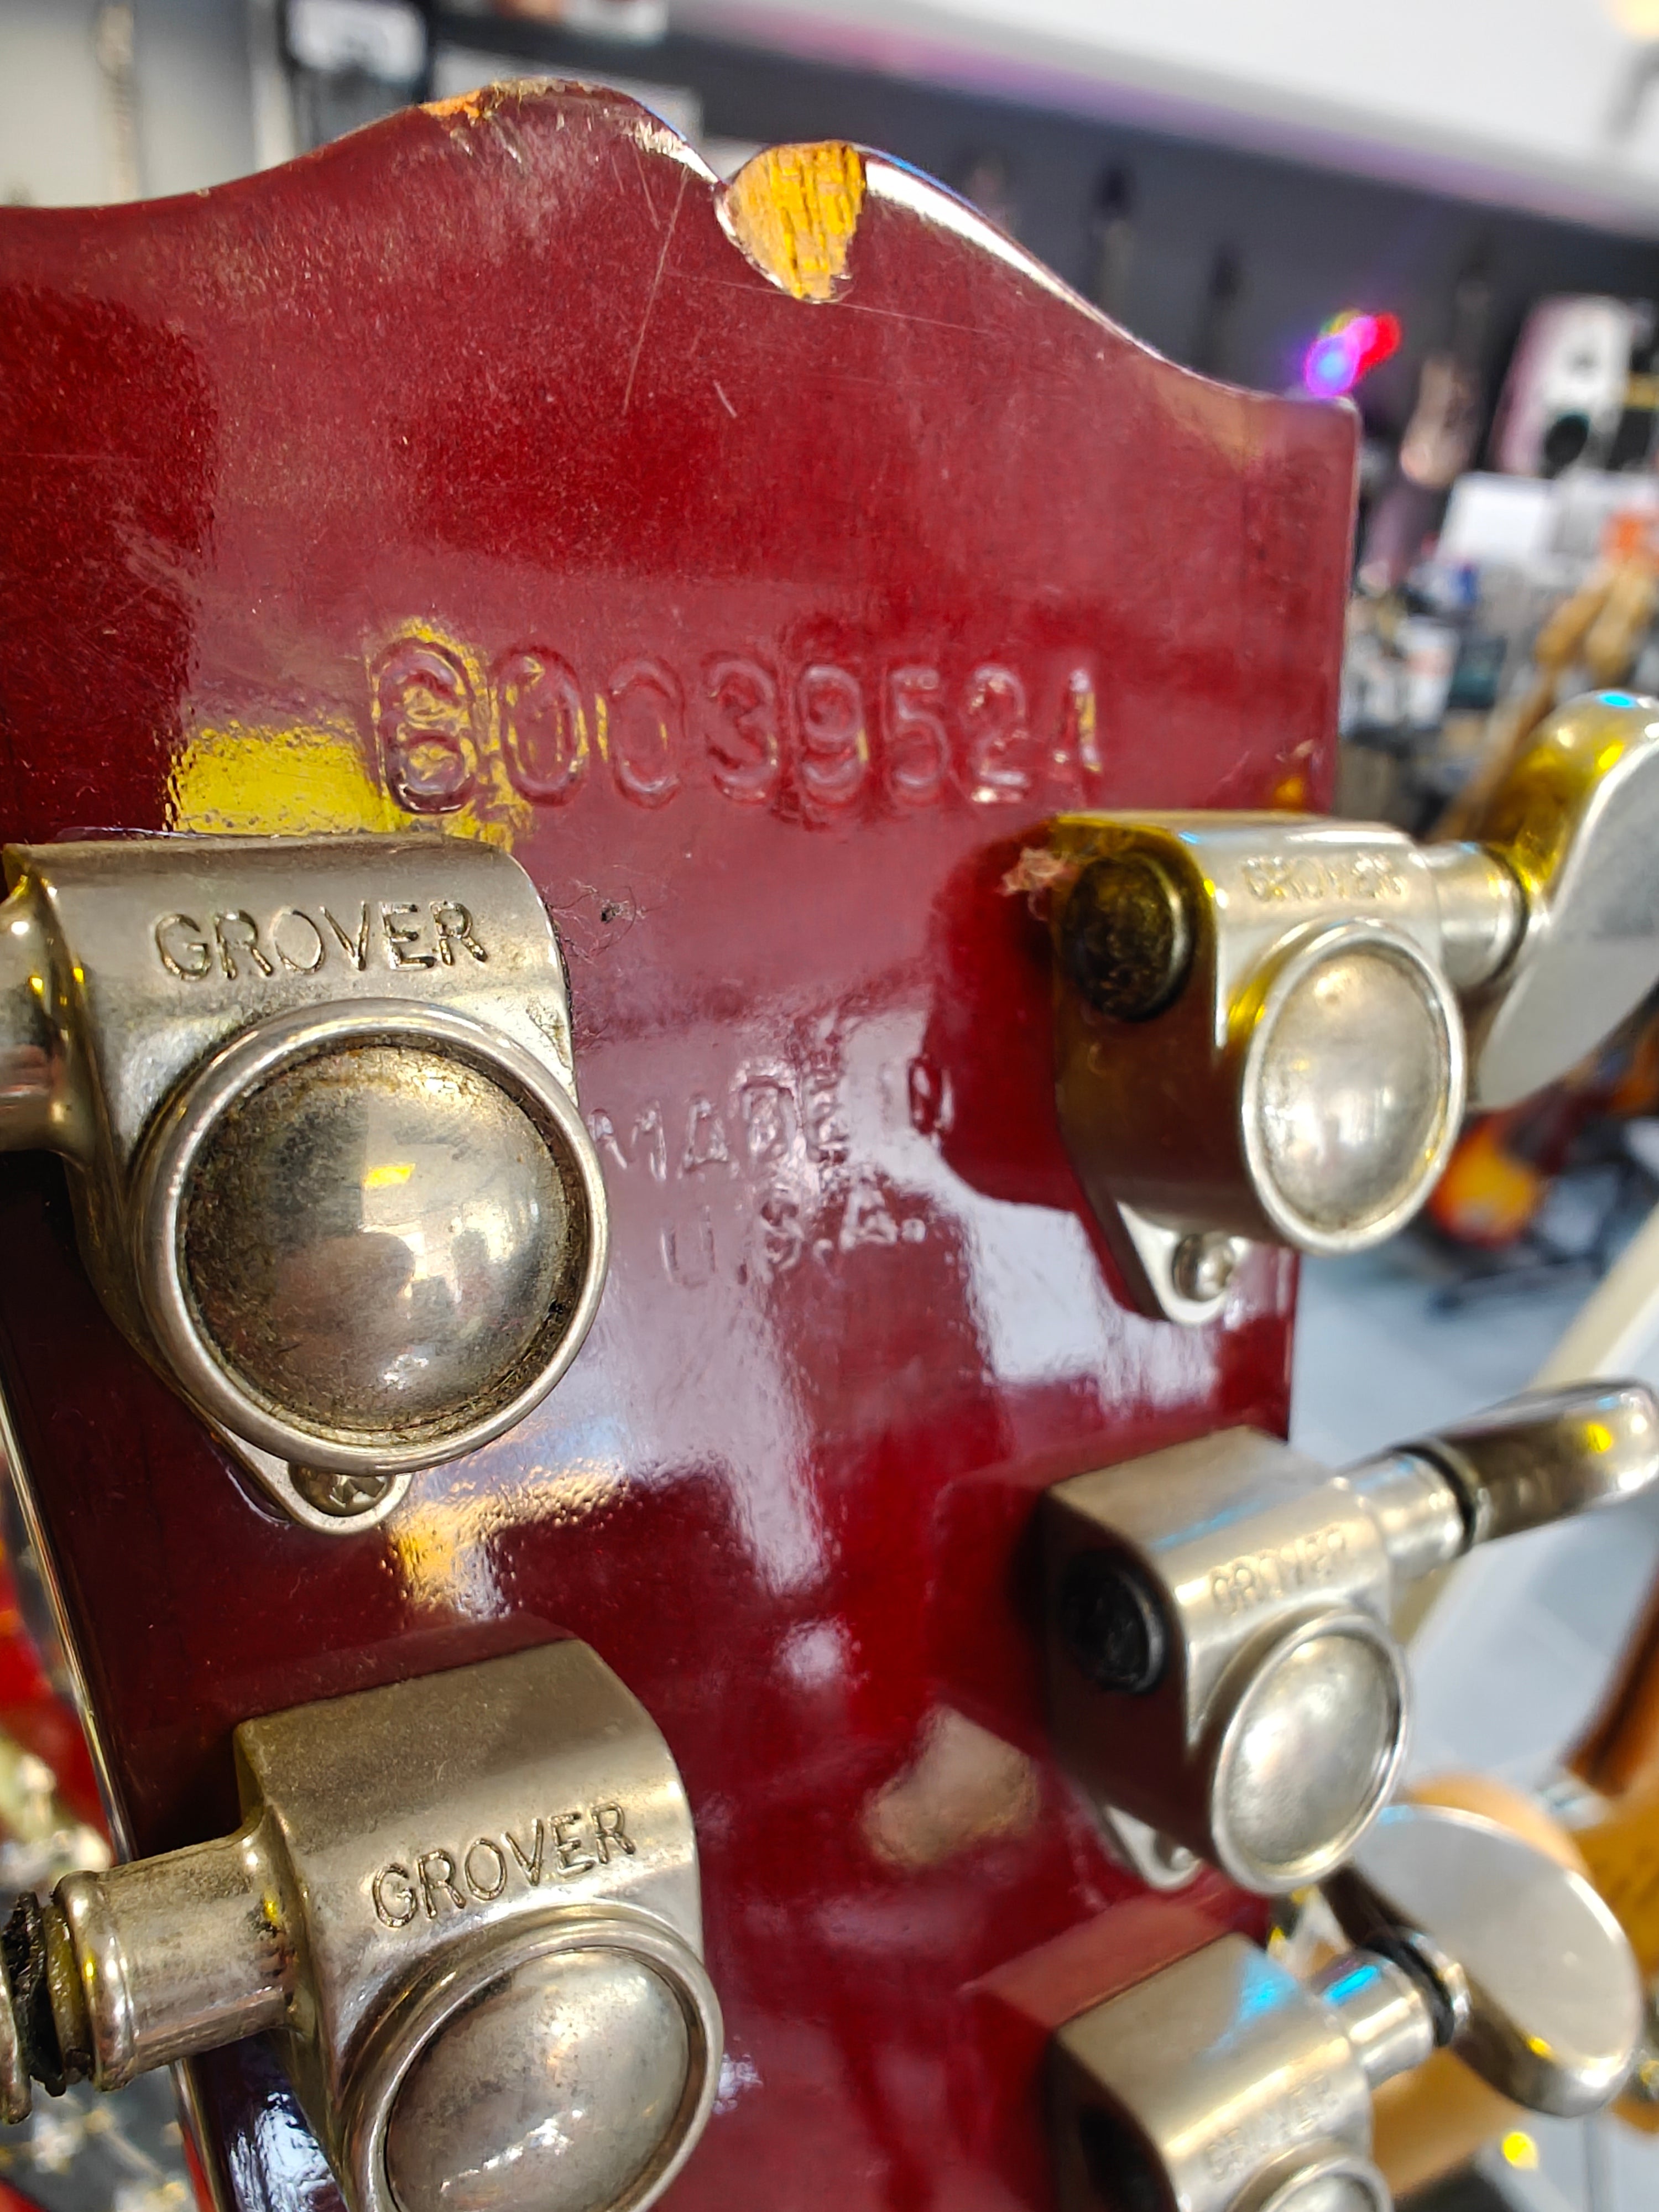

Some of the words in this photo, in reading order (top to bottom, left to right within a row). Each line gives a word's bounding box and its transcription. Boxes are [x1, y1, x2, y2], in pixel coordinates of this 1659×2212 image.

[155, 899, 490, 982] GROVER
[587, 1055, 850, 1181] MADE
[371, 1801, 637, 1928] GROVER
